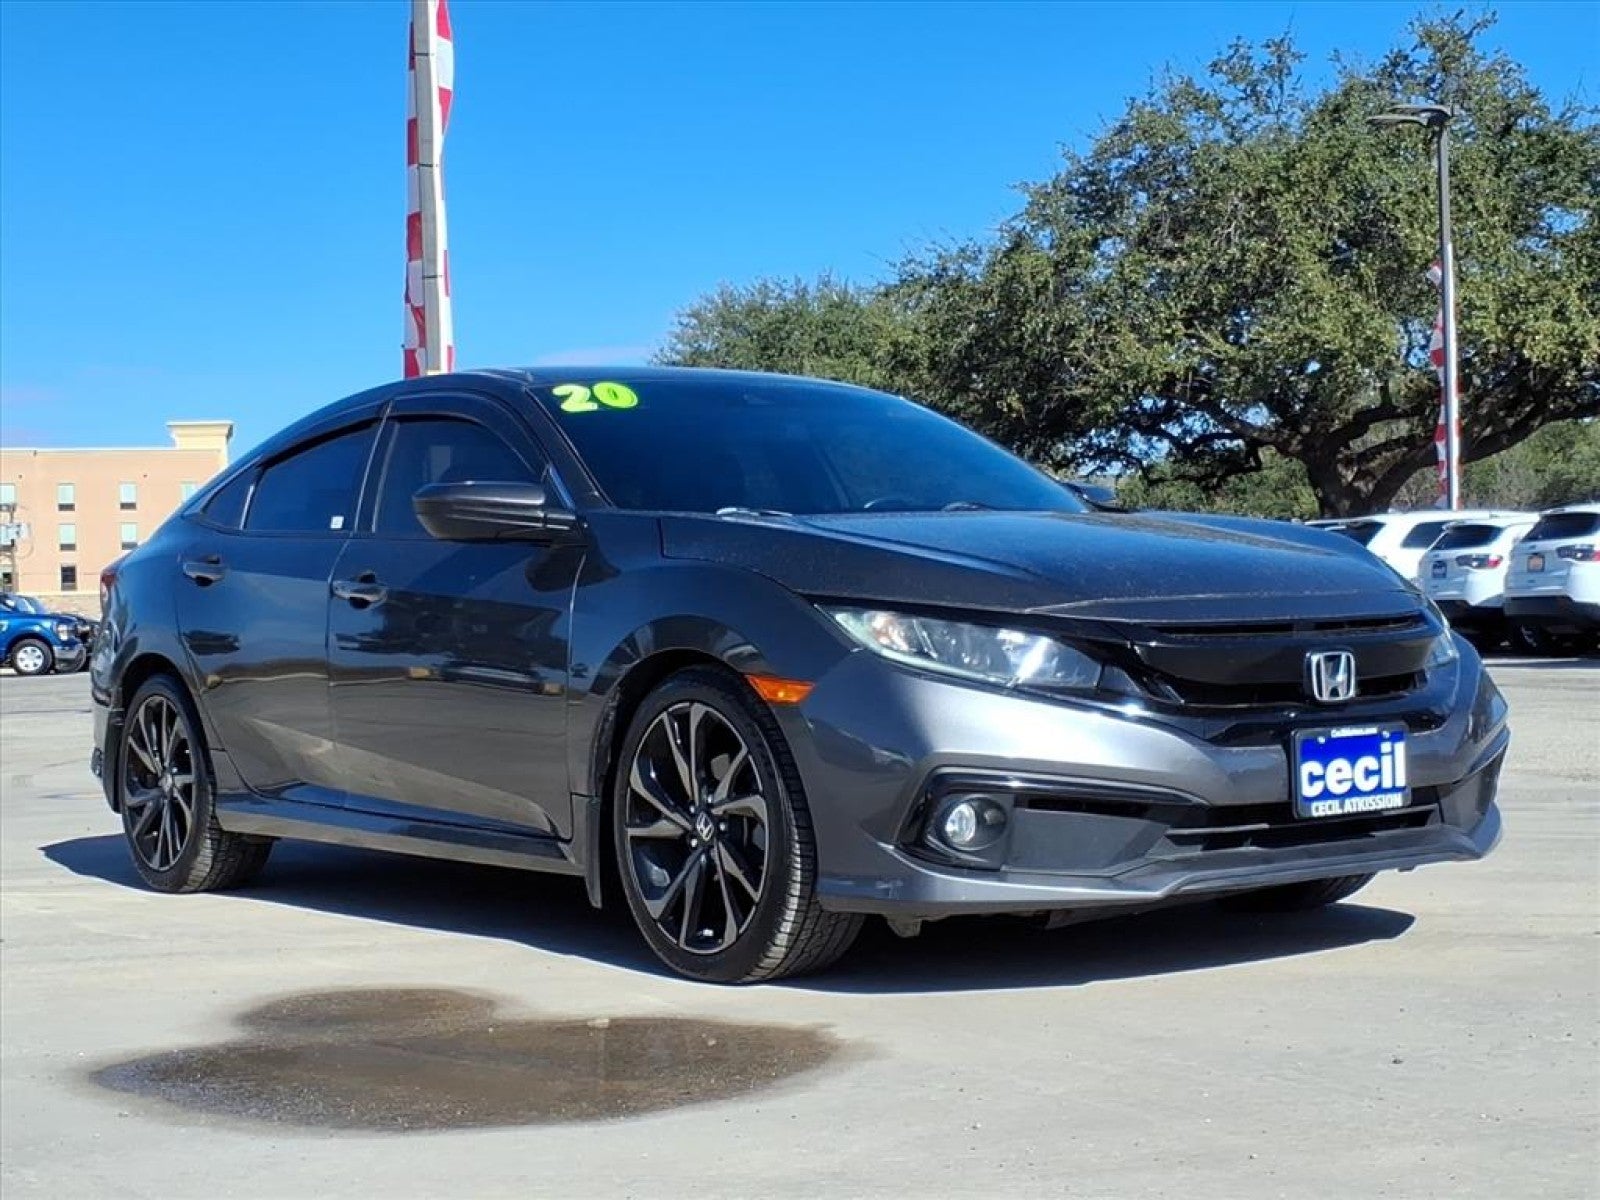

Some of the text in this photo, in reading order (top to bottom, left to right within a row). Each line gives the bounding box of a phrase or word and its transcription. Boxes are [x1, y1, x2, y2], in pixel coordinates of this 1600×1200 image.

[552, 383, 638, 412] 20
[1300, 741, 1406, 798] cecil
[1311, 800, 1342, 817] CECIL
